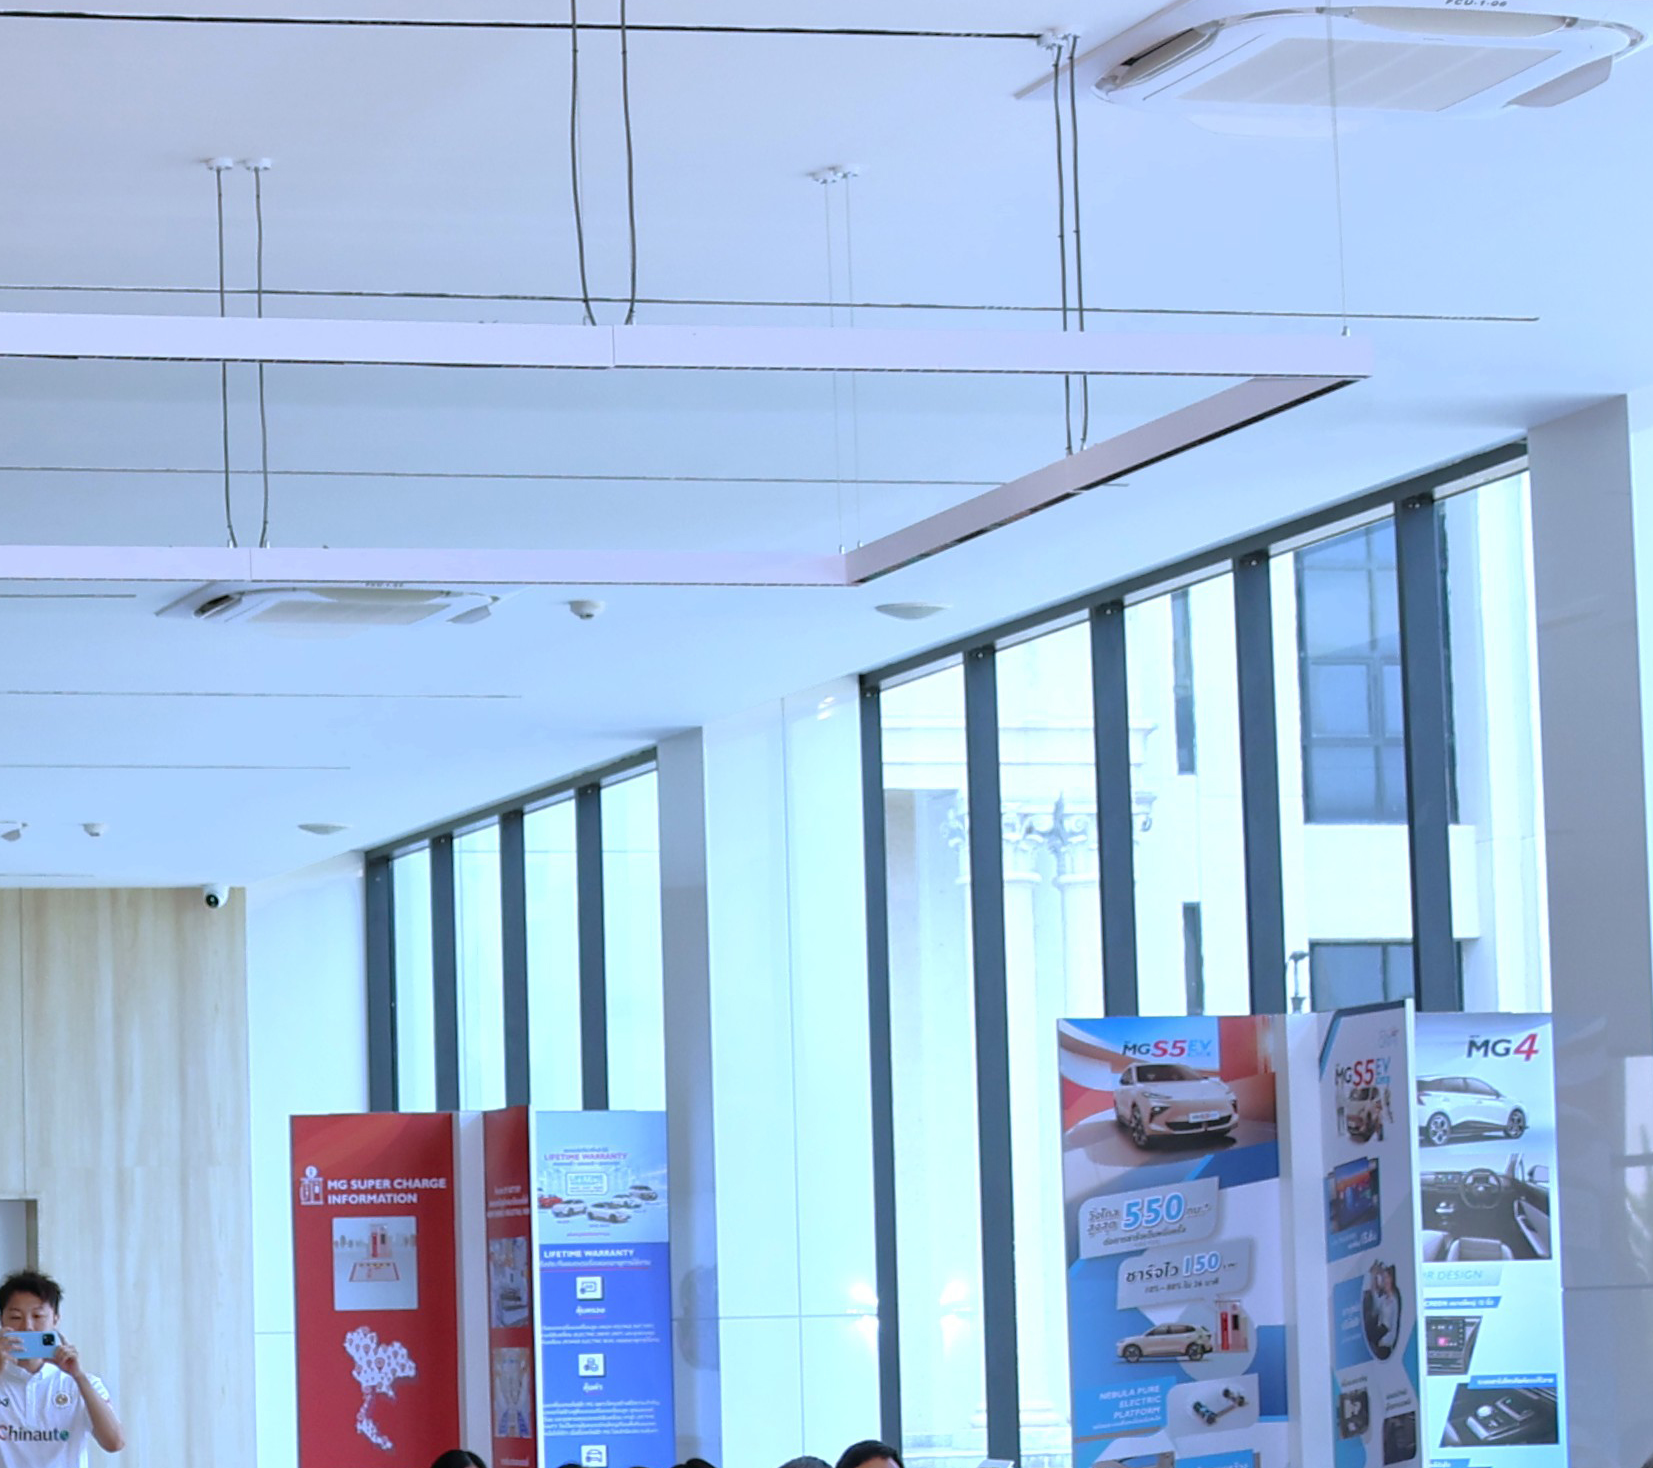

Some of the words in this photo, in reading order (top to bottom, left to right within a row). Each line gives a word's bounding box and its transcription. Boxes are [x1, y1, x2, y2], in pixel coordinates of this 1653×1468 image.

[327, 1179, 348, 1190] MG
[351, 1179, 391, 1190] SUPER
[393, 1178, 447, 1189] CHARGE
[327, 1193, 418, 1204] INFORMATION
[1122, 1192, 1185, 1231] 550
[543, 1250, 582, 1258] LIFETIME
[1182, 1252, 1220, 1277] 150
